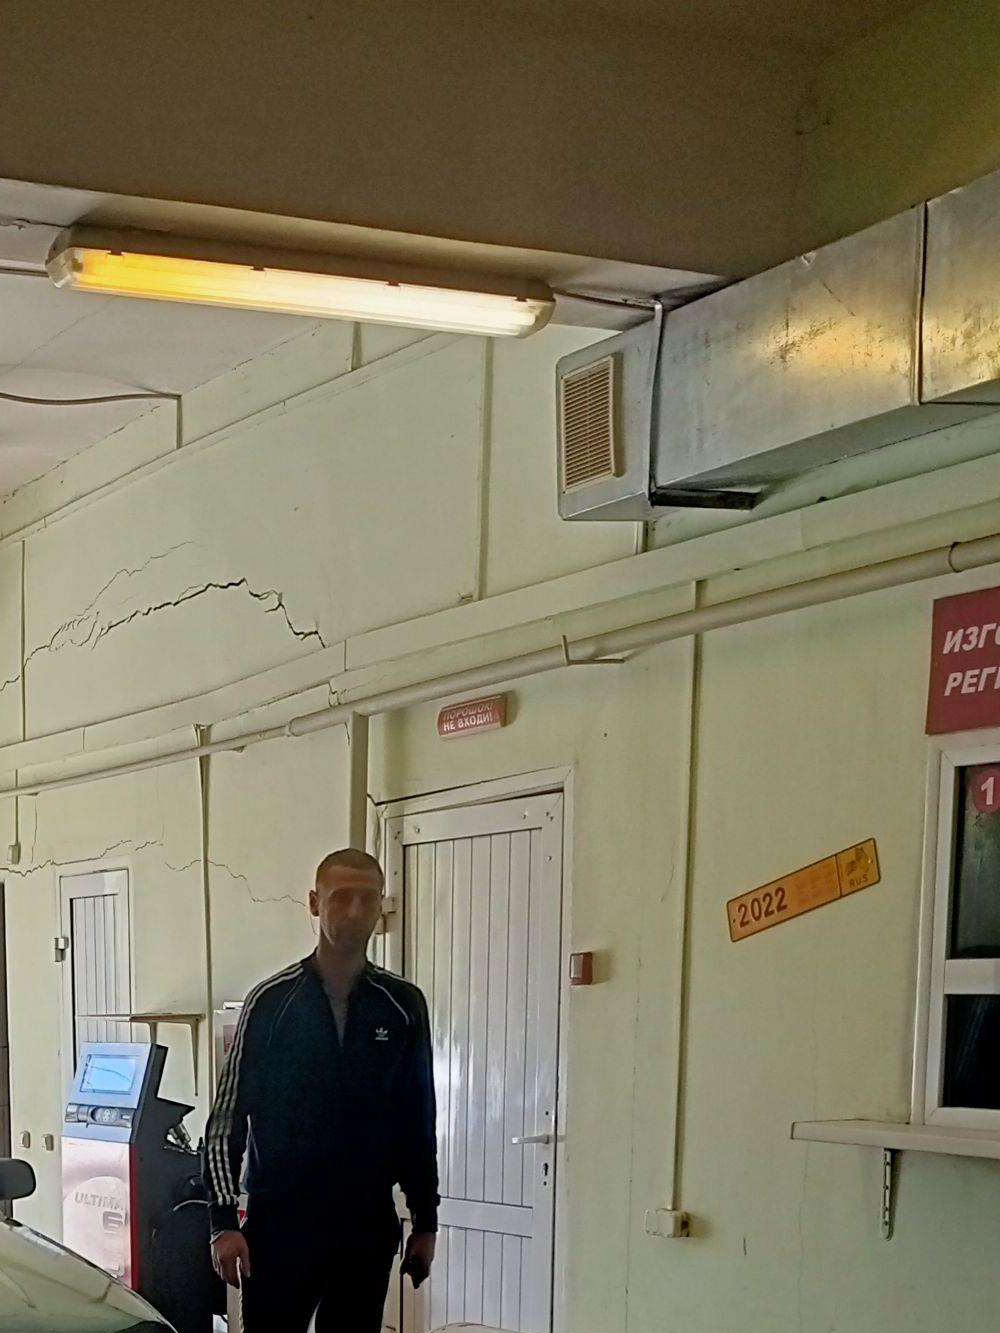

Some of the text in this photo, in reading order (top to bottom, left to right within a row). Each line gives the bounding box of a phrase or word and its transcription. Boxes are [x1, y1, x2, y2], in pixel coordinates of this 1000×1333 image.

[443, 711, 493, 731] НЕ ВХОДИ!
[980, 776, 995, 806] 1
[848, 874, 869, 888] RUS
[737, 887, 787, 928] 2022
